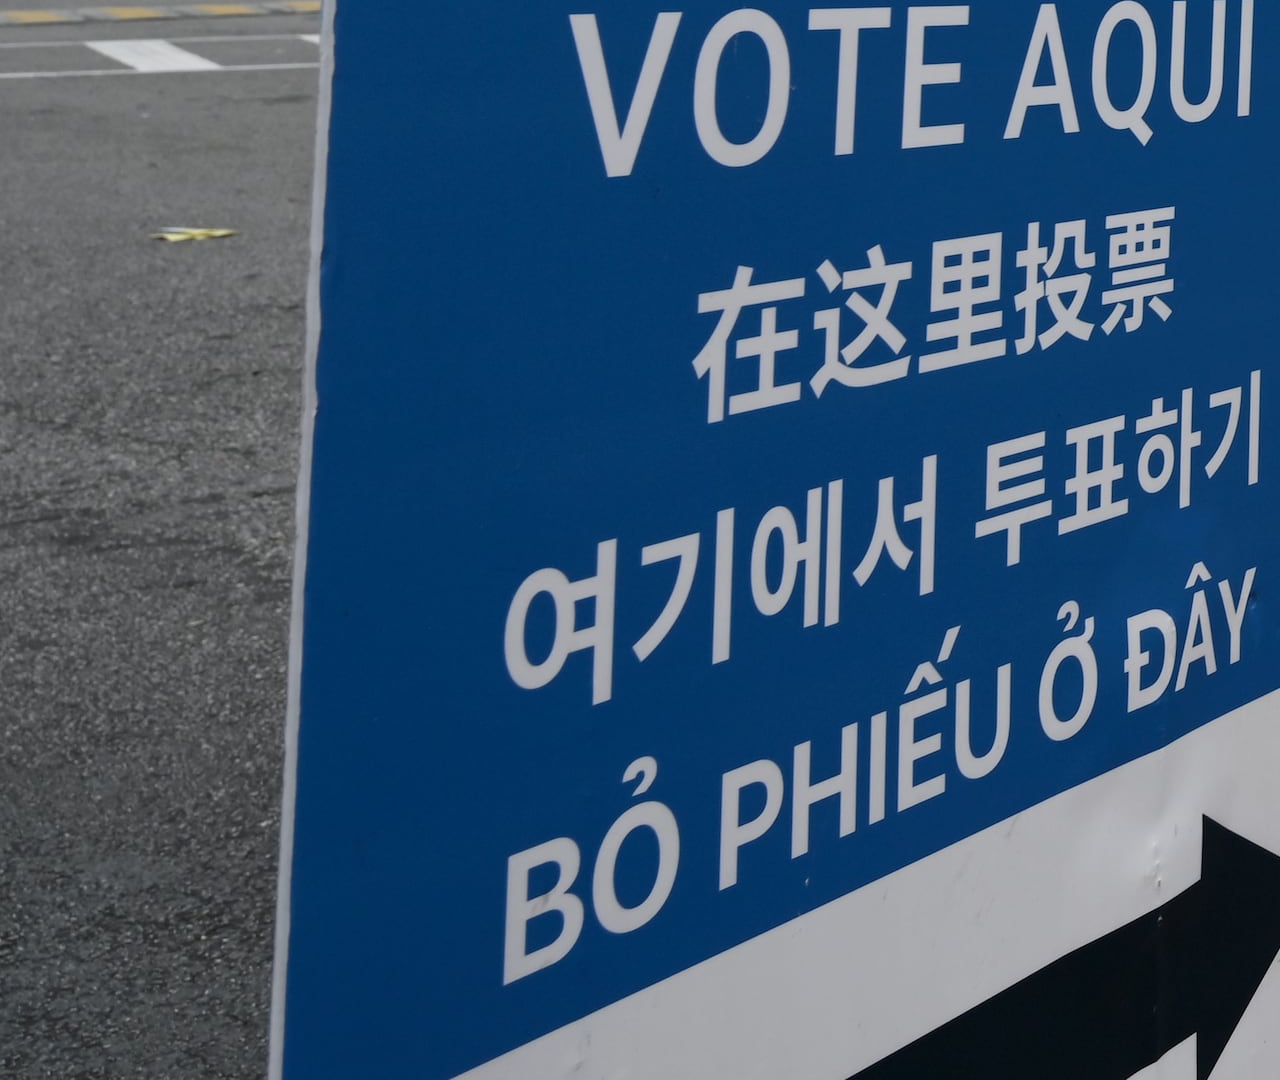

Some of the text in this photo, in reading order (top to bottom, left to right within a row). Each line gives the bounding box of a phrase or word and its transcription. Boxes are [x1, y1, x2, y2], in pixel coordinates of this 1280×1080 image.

[569, 6, 969, 177] VOTE
[692, 207, 1175, 423] 在这里投票
[505, 370, 1260, 706] 여기에서 투표하기
[504, 561, 1257, 985] BỎ PHIẾU Ở ĐÂY
